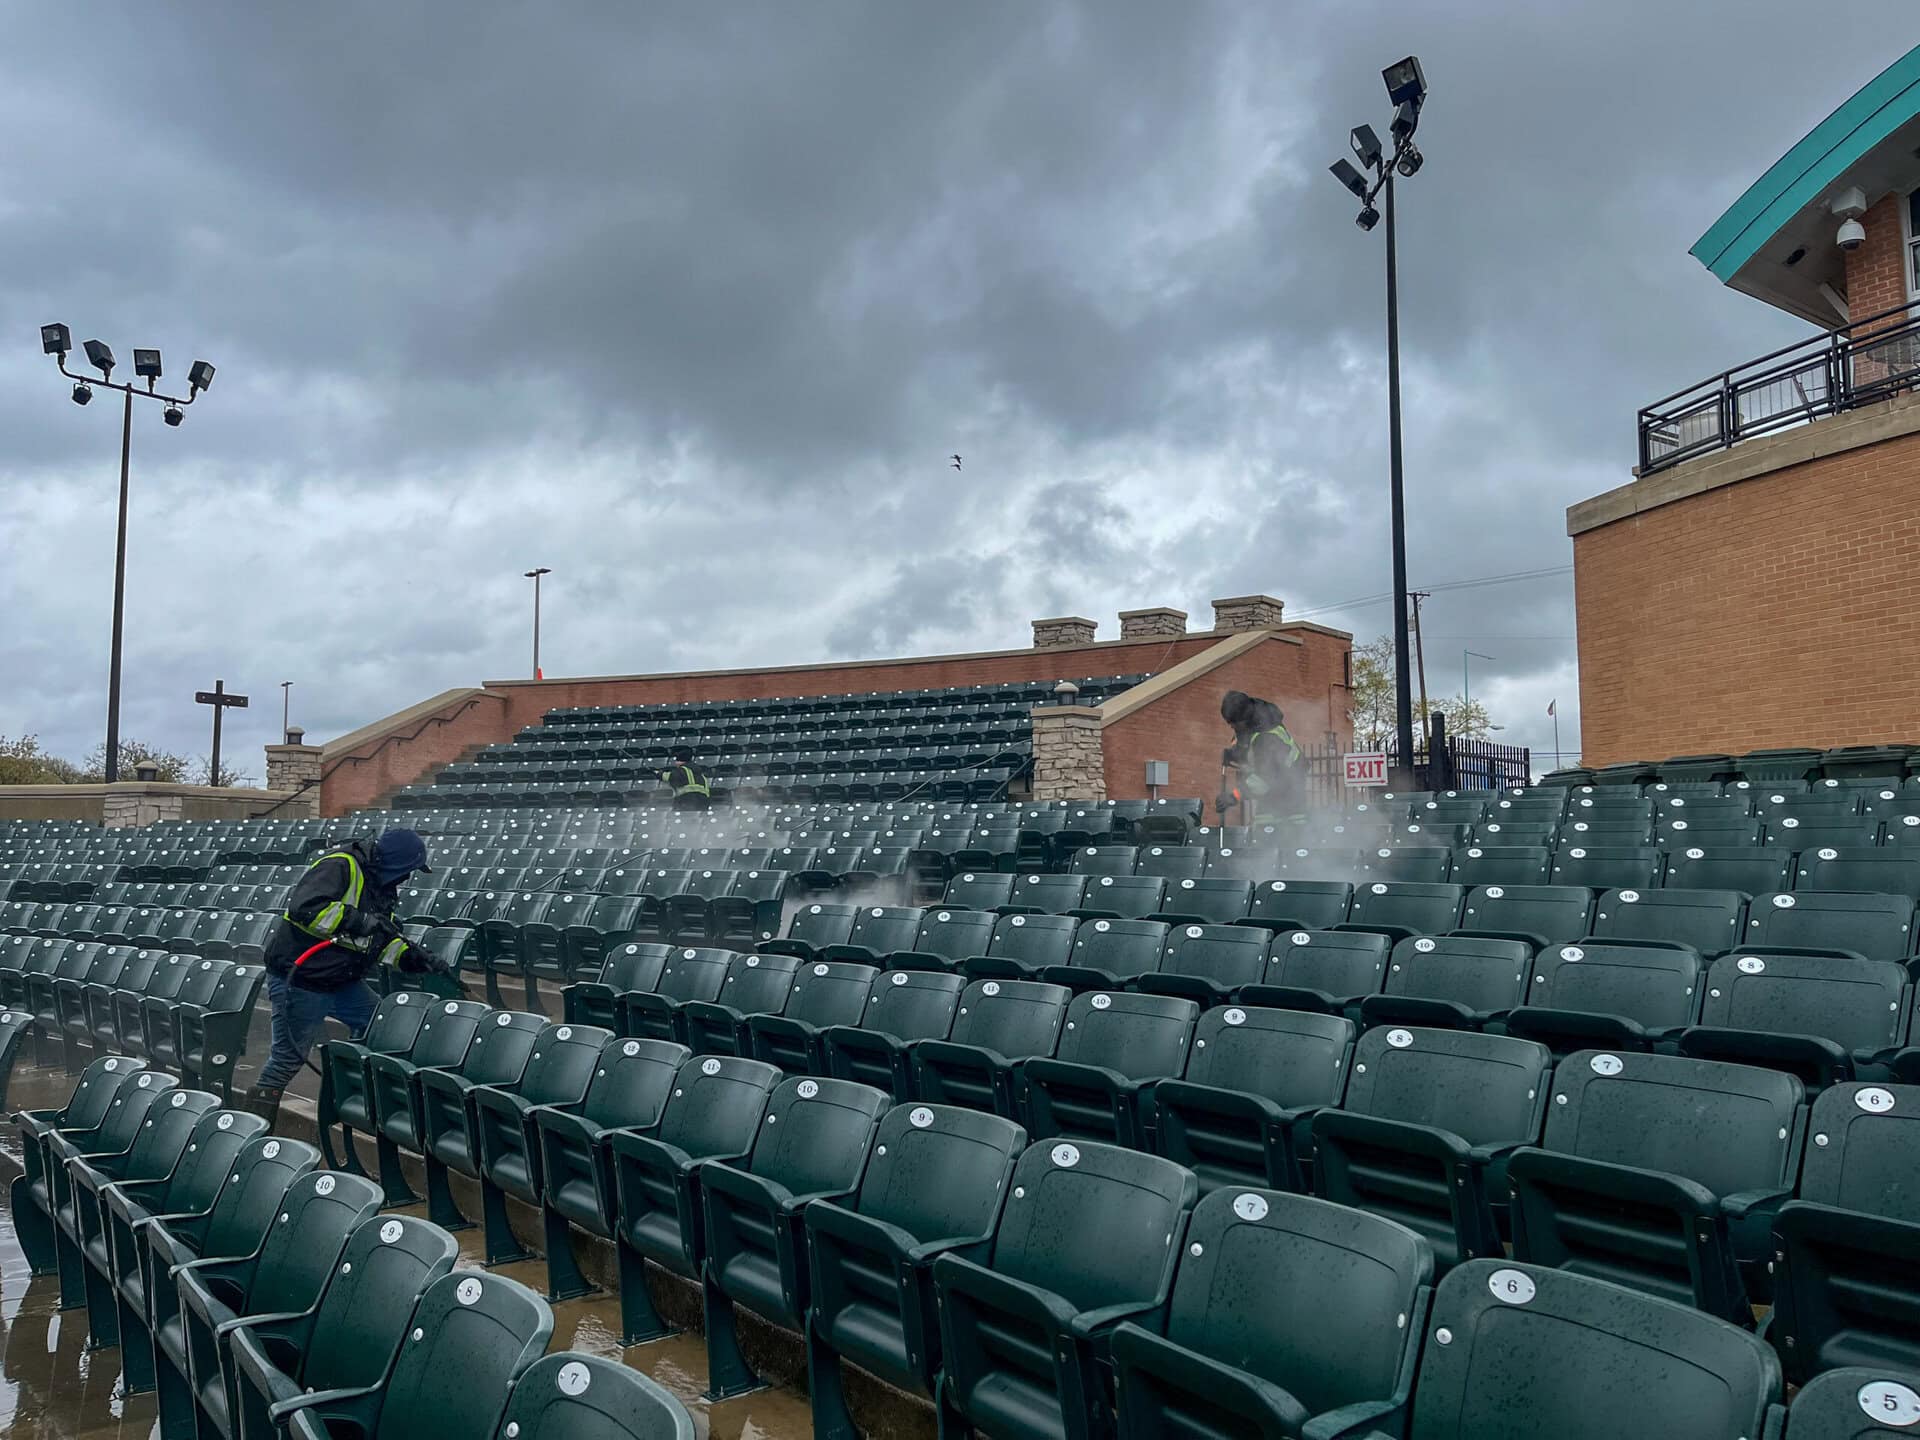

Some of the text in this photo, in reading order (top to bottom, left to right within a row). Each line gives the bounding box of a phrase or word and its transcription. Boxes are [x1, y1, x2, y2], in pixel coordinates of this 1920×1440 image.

[1346, 760, 1385, 779] EXIT
[1247, 1202, 1256, 1214] 7
[1507, 1279, 1518, 1294] 6
[570, 1372, 580, 1386] 7
[1883, 1393, 1898, 1412] 5
